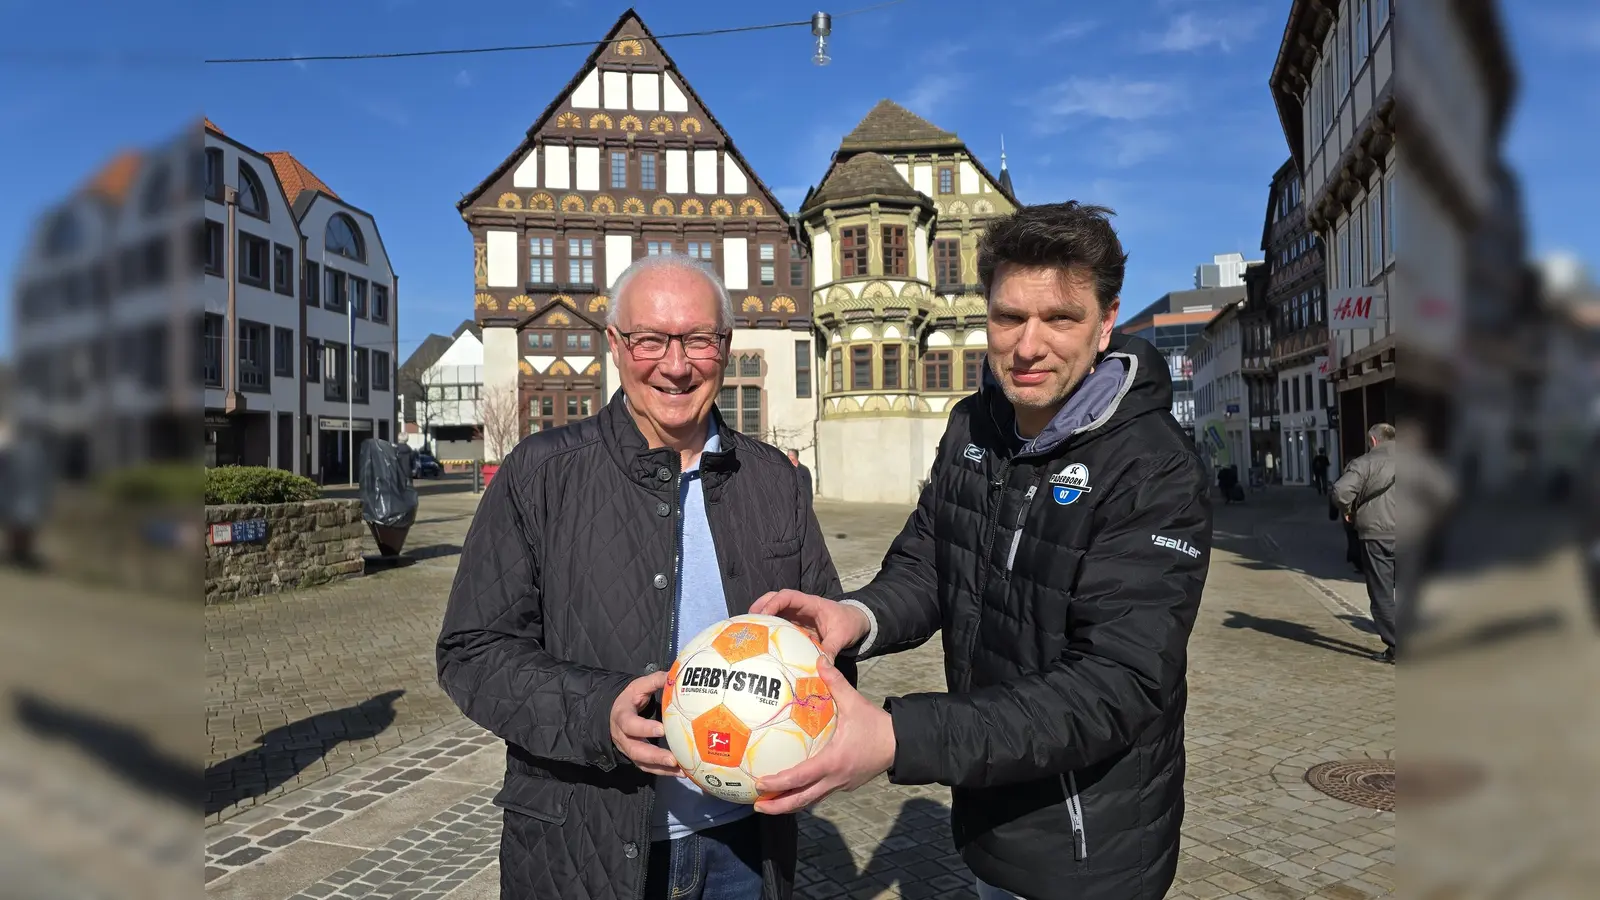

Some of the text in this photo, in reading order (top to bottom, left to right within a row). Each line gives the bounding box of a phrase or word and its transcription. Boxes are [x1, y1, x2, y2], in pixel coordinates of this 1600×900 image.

[1333, 296, 1372, 320] H&M
[1050, 474, 1083, 485] PADERBORN
[1060, 490, 1069, 499] 07
[682, 667, 781, 700] DERBYSTAR
[759, 697, 778, 706] SELECT
